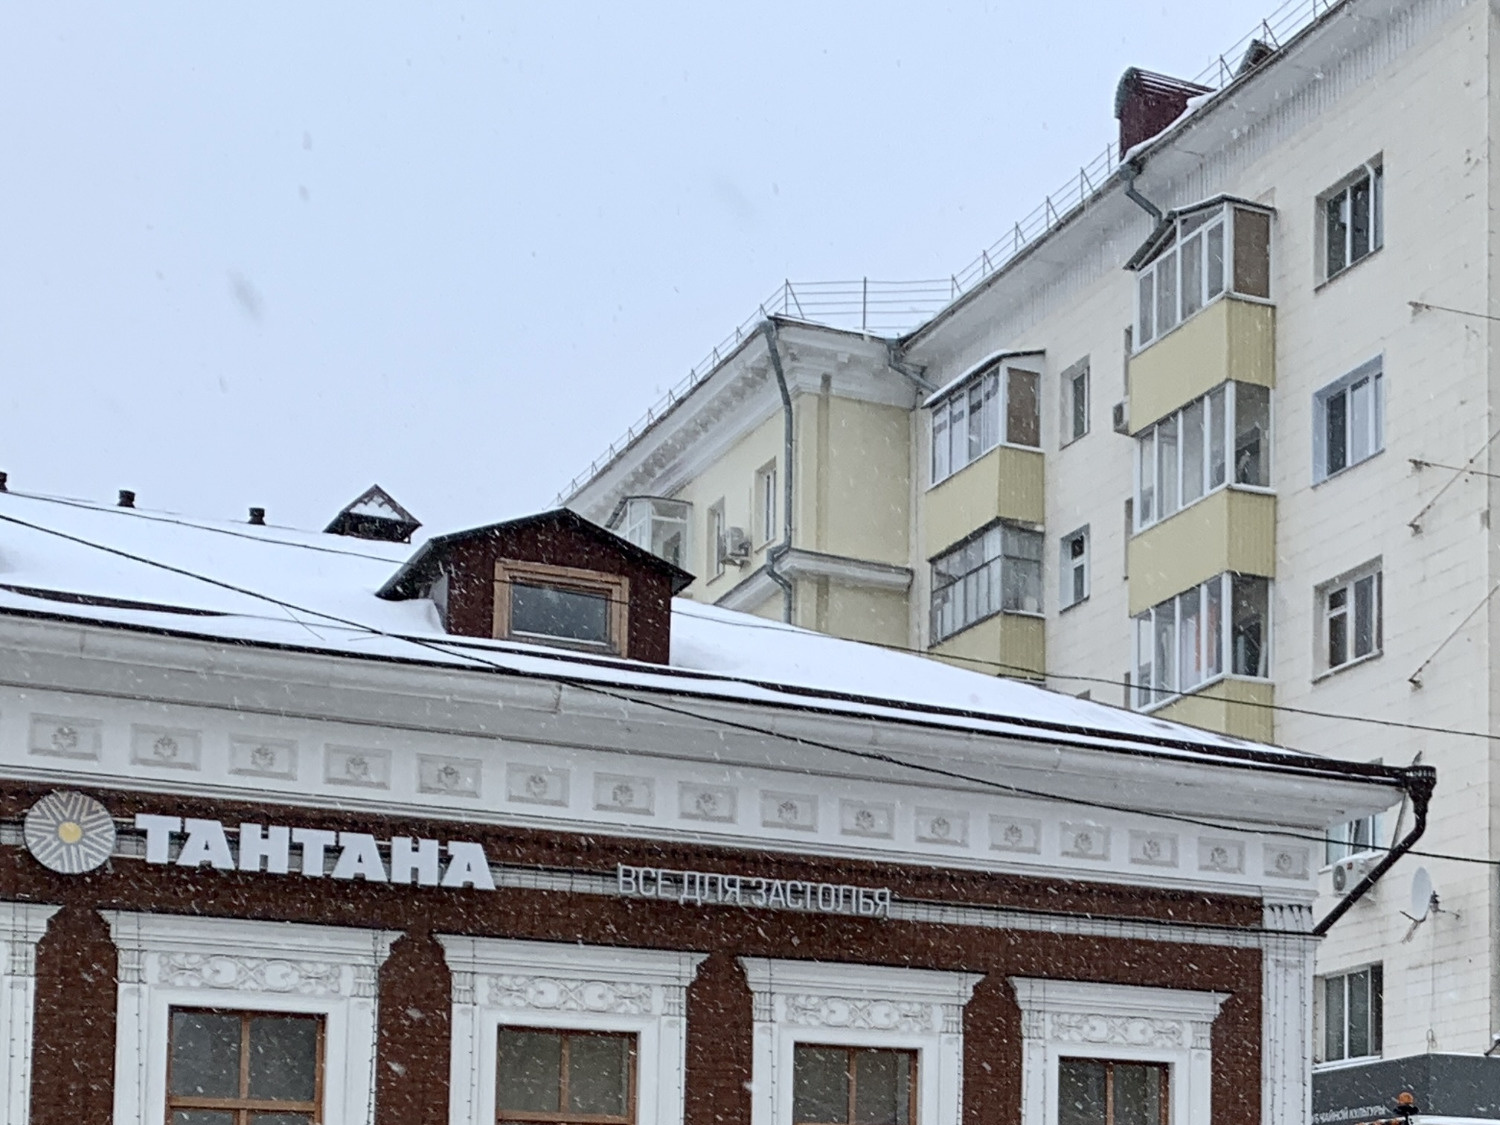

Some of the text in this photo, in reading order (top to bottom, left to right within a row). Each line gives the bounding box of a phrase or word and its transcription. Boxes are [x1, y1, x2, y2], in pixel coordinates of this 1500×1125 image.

[135, 813, 496, 891] ТАНТАНА
[617, 863, 891, 916] ВСЕ ДЛЯ ЗАСТОЛЬЯ
